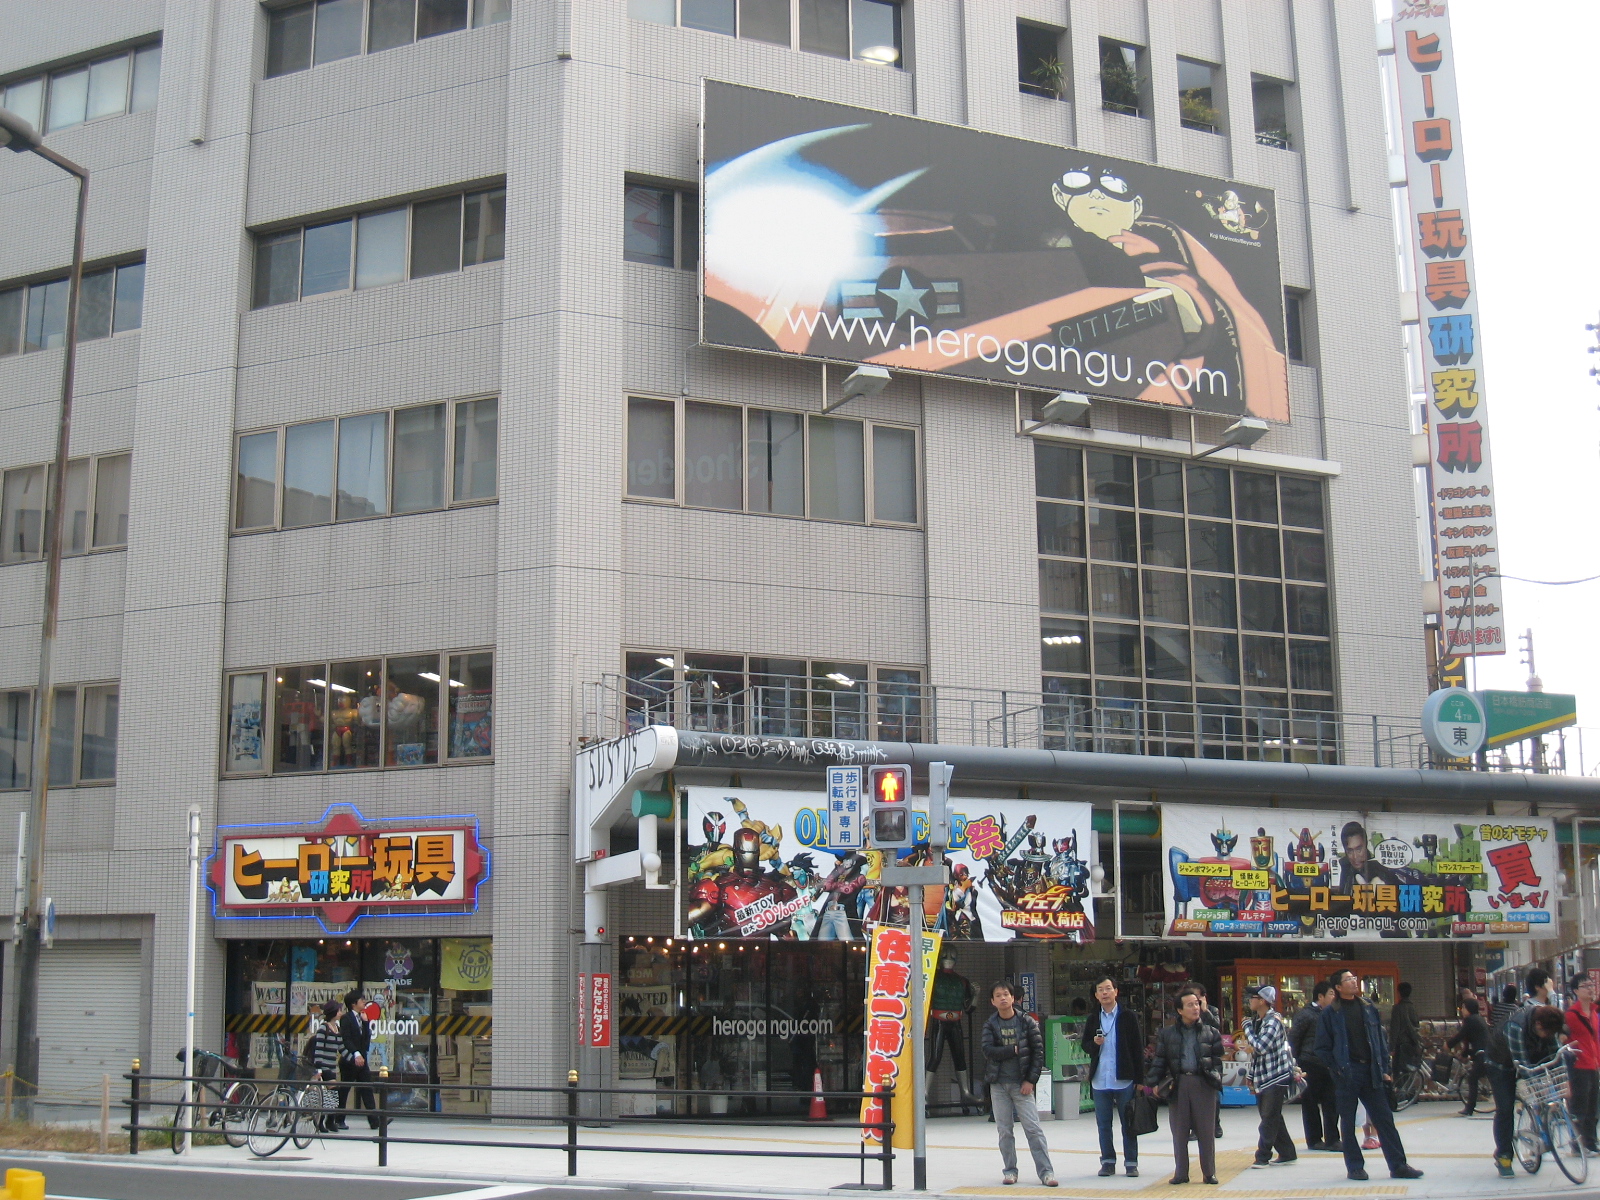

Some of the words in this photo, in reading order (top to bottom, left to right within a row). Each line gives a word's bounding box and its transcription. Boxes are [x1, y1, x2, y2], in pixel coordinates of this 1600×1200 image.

[1405, 30, 1483, 474] ヒーロー玩具研究所
[1057, 298, 1163, 349] CITIZEN
[783, 305, 1229, 398] www.herogangu.com
[1444, 525, 1494, 539] キン肉マン
[1452, 726, 1469, 747] 東
[831, 771, 844, 813] 自転車
[844, 771, 858, 813] 歩行者
[838, 815, 851, 843] 専用
[965, 815, 1005, 861] 祭
[1479, 824, 1548, 842] 昔のオモチャ
[233, 834, 456, 894] ヒーロー玩具
[1296, 866, 1317, 874] 超合金
[1438, 863, 1480, 871] トランスフォーマー
[1486, 841, 1542, 895] 買
[309, 869, 373, 895] 研究所
[736, 894, 774, 922] 最新TOY
[1270, 884, 1468, 913] ヒーロー玩具研究所
[1488, 890, 1549, 909] います!
[1002, 911, 1085, 928] 限定品入荷店
[1268, 922, 1297, 931] ミクロマン
[1468, 913, 1500, 921] ダイアクロン
[593, 977, 603, 1042] でんでんタウン
